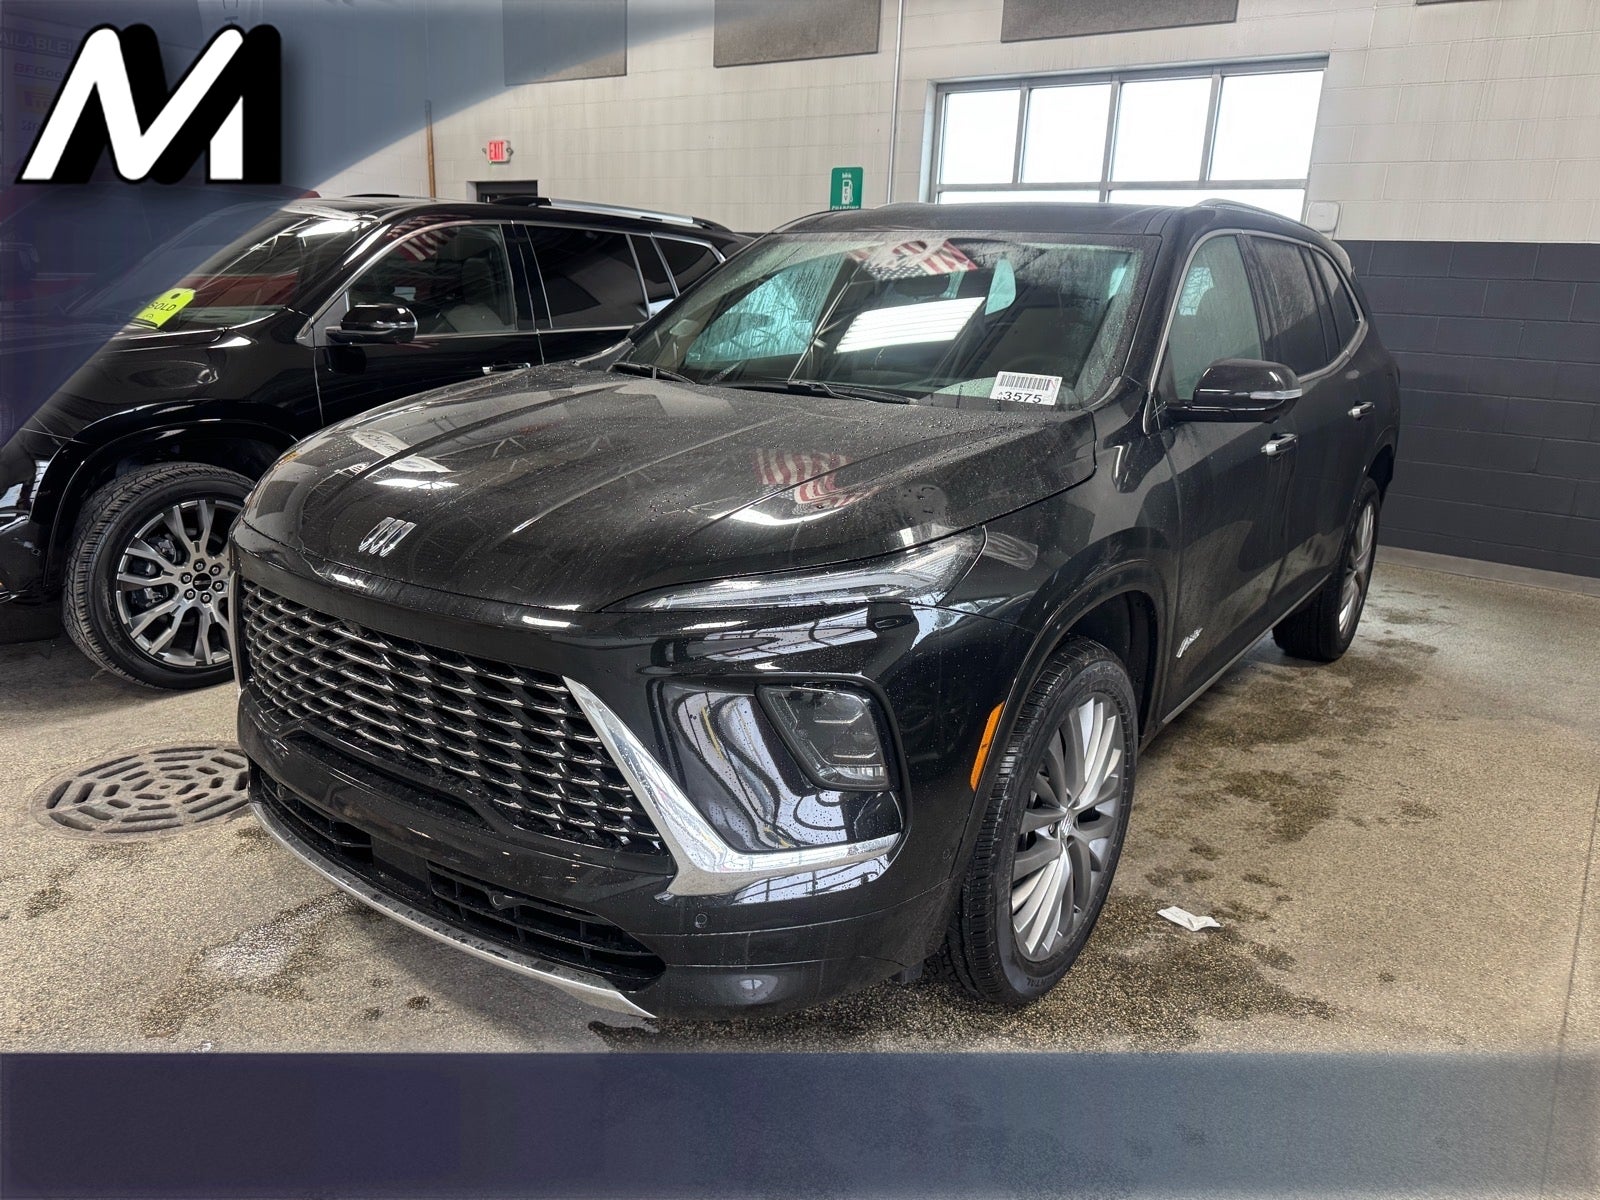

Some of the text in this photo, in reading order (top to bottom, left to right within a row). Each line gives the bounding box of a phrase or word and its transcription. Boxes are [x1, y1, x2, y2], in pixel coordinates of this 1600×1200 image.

[489, 142, 504, 160] EXIT
[147, 302, 176, 311] SOLD
[1003, 391, 1043, 404] 3575
